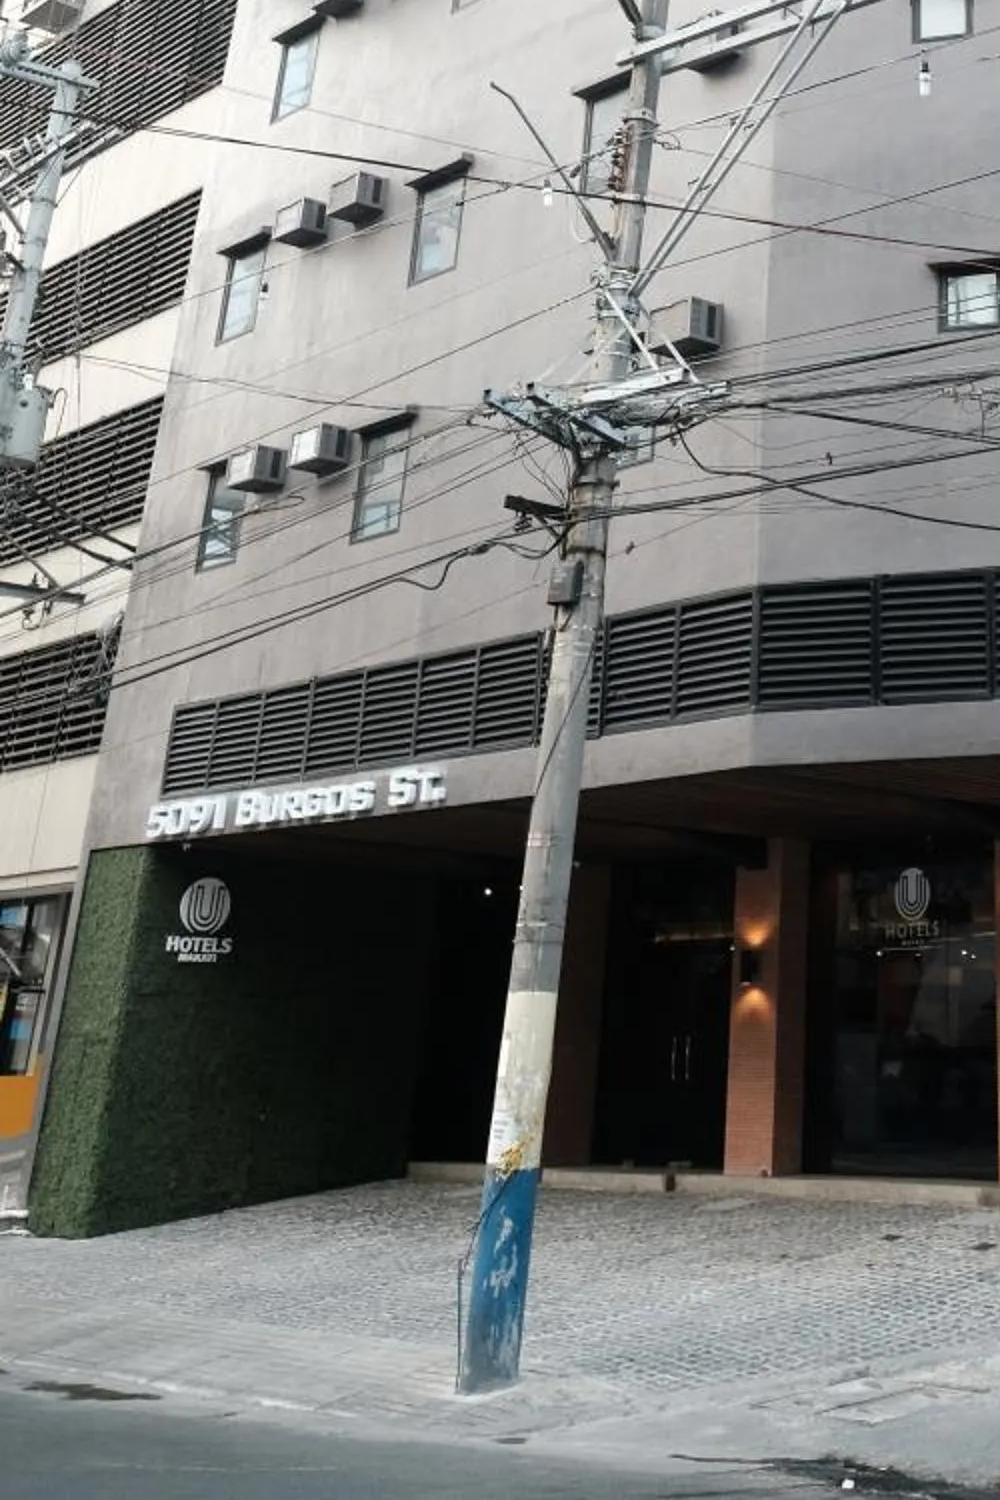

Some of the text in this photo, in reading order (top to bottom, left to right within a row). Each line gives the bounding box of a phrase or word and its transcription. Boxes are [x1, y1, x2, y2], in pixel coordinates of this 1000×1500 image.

[146, 798, 227, 838] 5091
[885, 921, 939, 939] HOTELS
[165, 935, 233, 954] HOTELS
